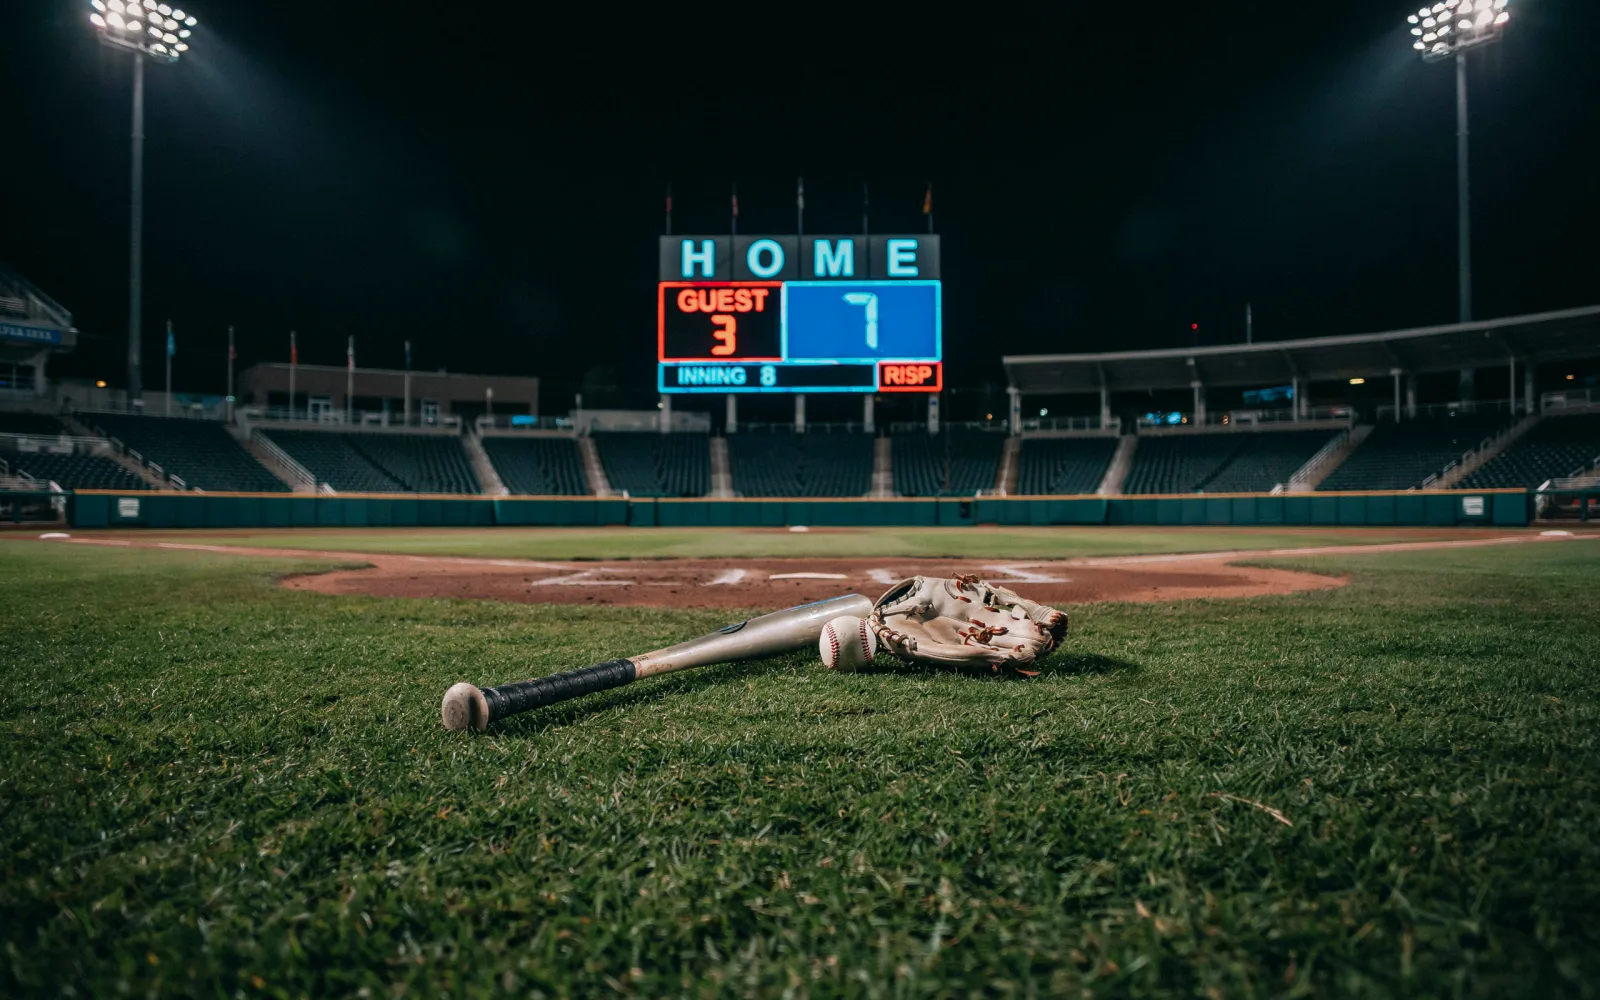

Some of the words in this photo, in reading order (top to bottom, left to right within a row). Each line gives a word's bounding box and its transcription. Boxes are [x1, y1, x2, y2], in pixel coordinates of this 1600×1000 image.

[681, 239, 919, 278] HOME
[677, 289, 769, 313] GUEST
[710, 314, 737, 356] 3
[842, 292, 878, 350] 7
[677, 366, 747, 385] INNING
[759, 366, 777, 386] 8
[883, 365, 933, 385] RISP
